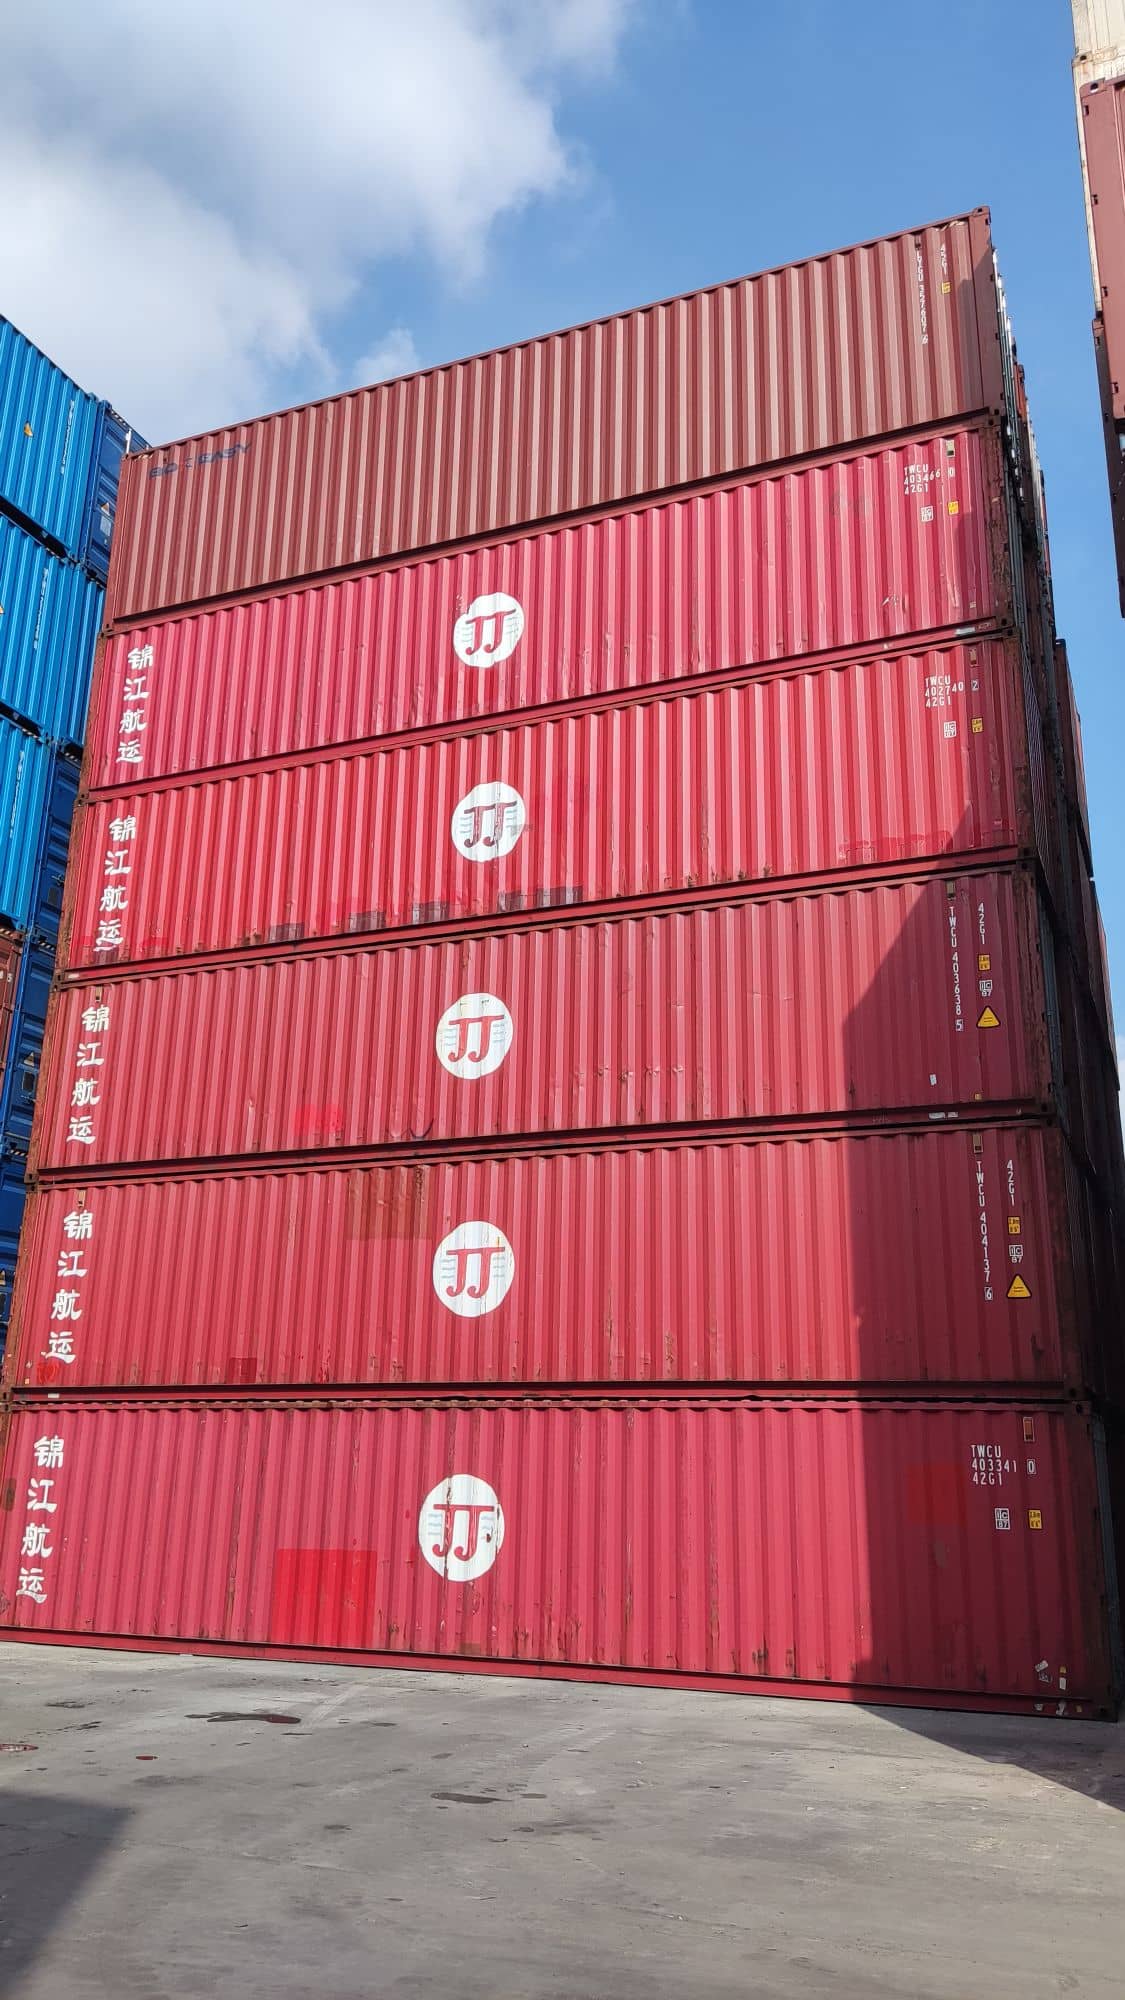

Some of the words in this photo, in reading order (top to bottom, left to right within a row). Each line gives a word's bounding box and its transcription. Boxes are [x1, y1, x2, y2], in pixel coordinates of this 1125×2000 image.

[904, 464, 928, 476] TWCU
[904, 469, 941, 486] 403466
[905, 483, 928, 495] 42G1
[925, 675, 951, 687] TWCU
[925, 682, 964, 698] 402740
[971, 680, 979, 691] 2
[116, 644, 154, 763] 锦江航运
[925, 696, 951, 708] 42G1
[94, 815, 137, 952] 锦江航运
[949, 906, 957, 948] TWCU
[952, 952, 961, 1015] 403638
[955, 1019, 964, 1032] 5
[66, 1004, 110, 1145] 锦江航运
[976, 1161, 985, 1207] TWCU
[1007, 1160, 1015, 1206] 42G1
[980, 1212, 990, 1282] 404137
[42, 1209, 93, 1364] 锦江航运
[985, 1287, 993, 1301] 6
[970, 1445, 1001, 1458] TWCU
[972, 1458, 1017, 1473] 403341
[1027, 1459, 1036, 1474] 0
[972, 1472, 1003, 1486] 42G1
[16, 1435, 65, 1604] 锦江航运
